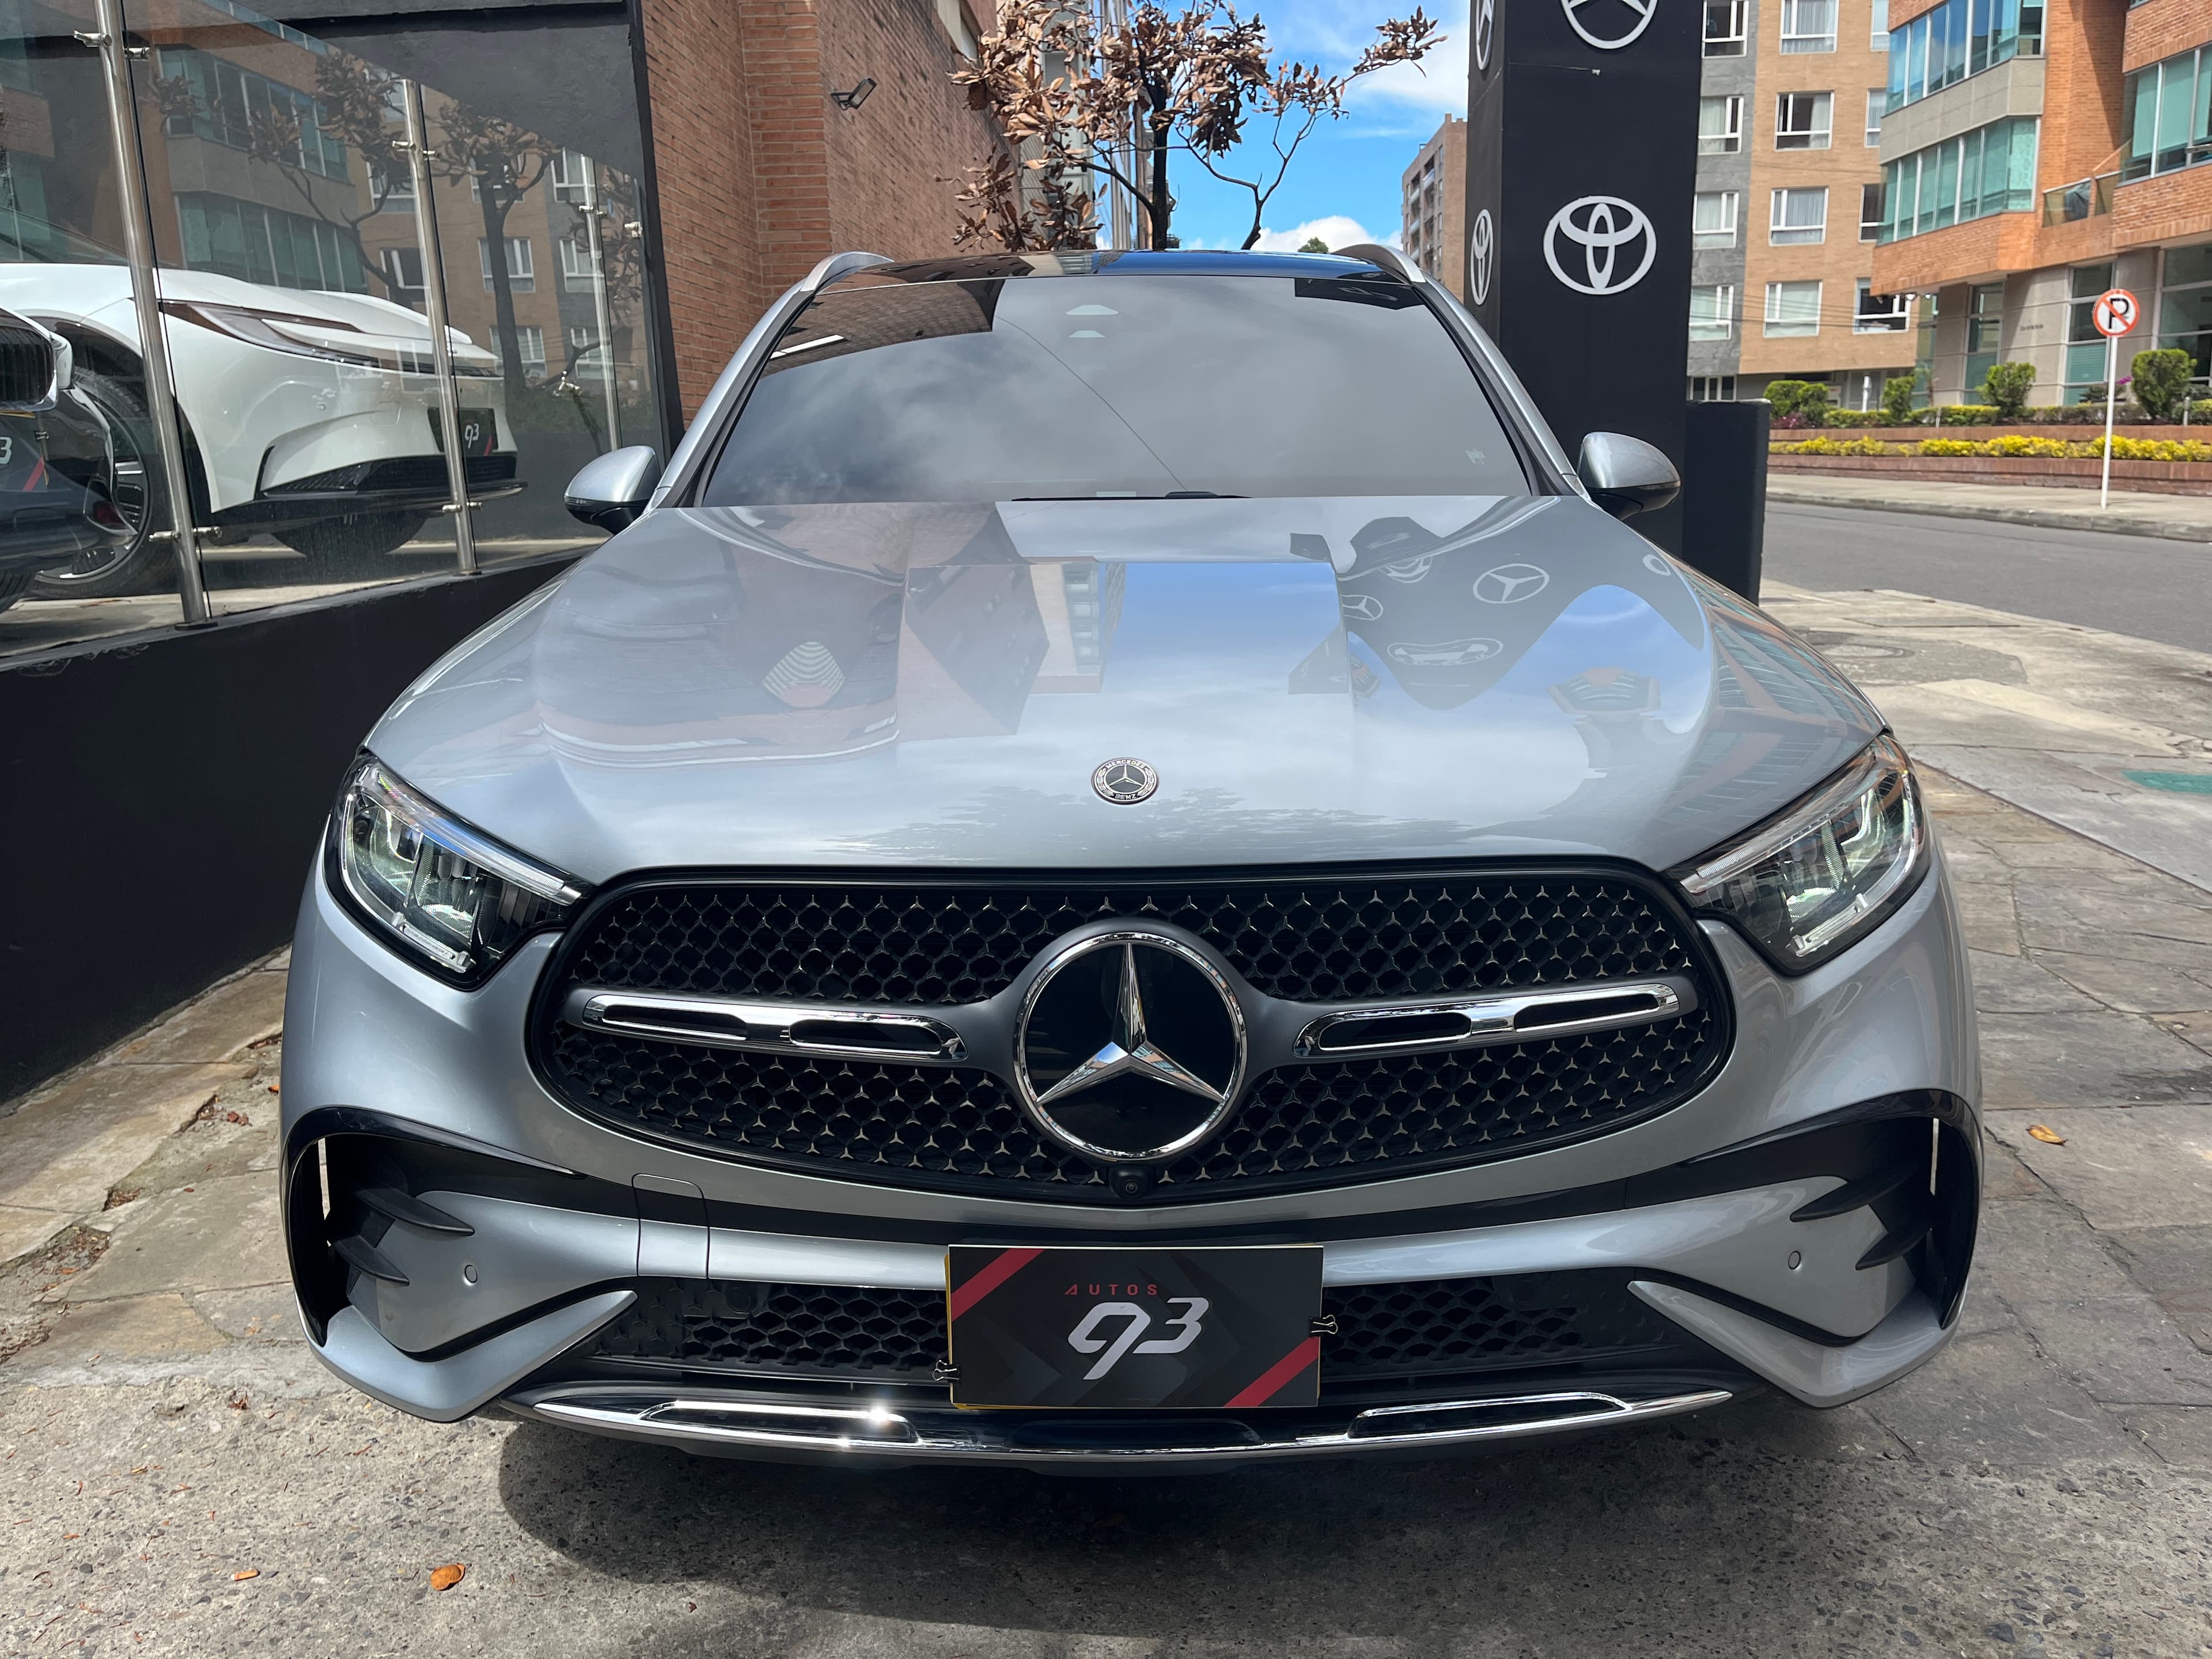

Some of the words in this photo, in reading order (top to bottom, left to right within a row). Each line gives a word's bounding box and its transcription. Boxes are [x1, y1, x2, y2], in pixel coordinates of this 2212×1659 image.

[464, 423, 479, 449] 93
[1105, 760, 1146, 769] MERCEDES
[1065, 1283, 1158, 1296] AUTOS
[1067, 1297, 1210, 1381] 93
